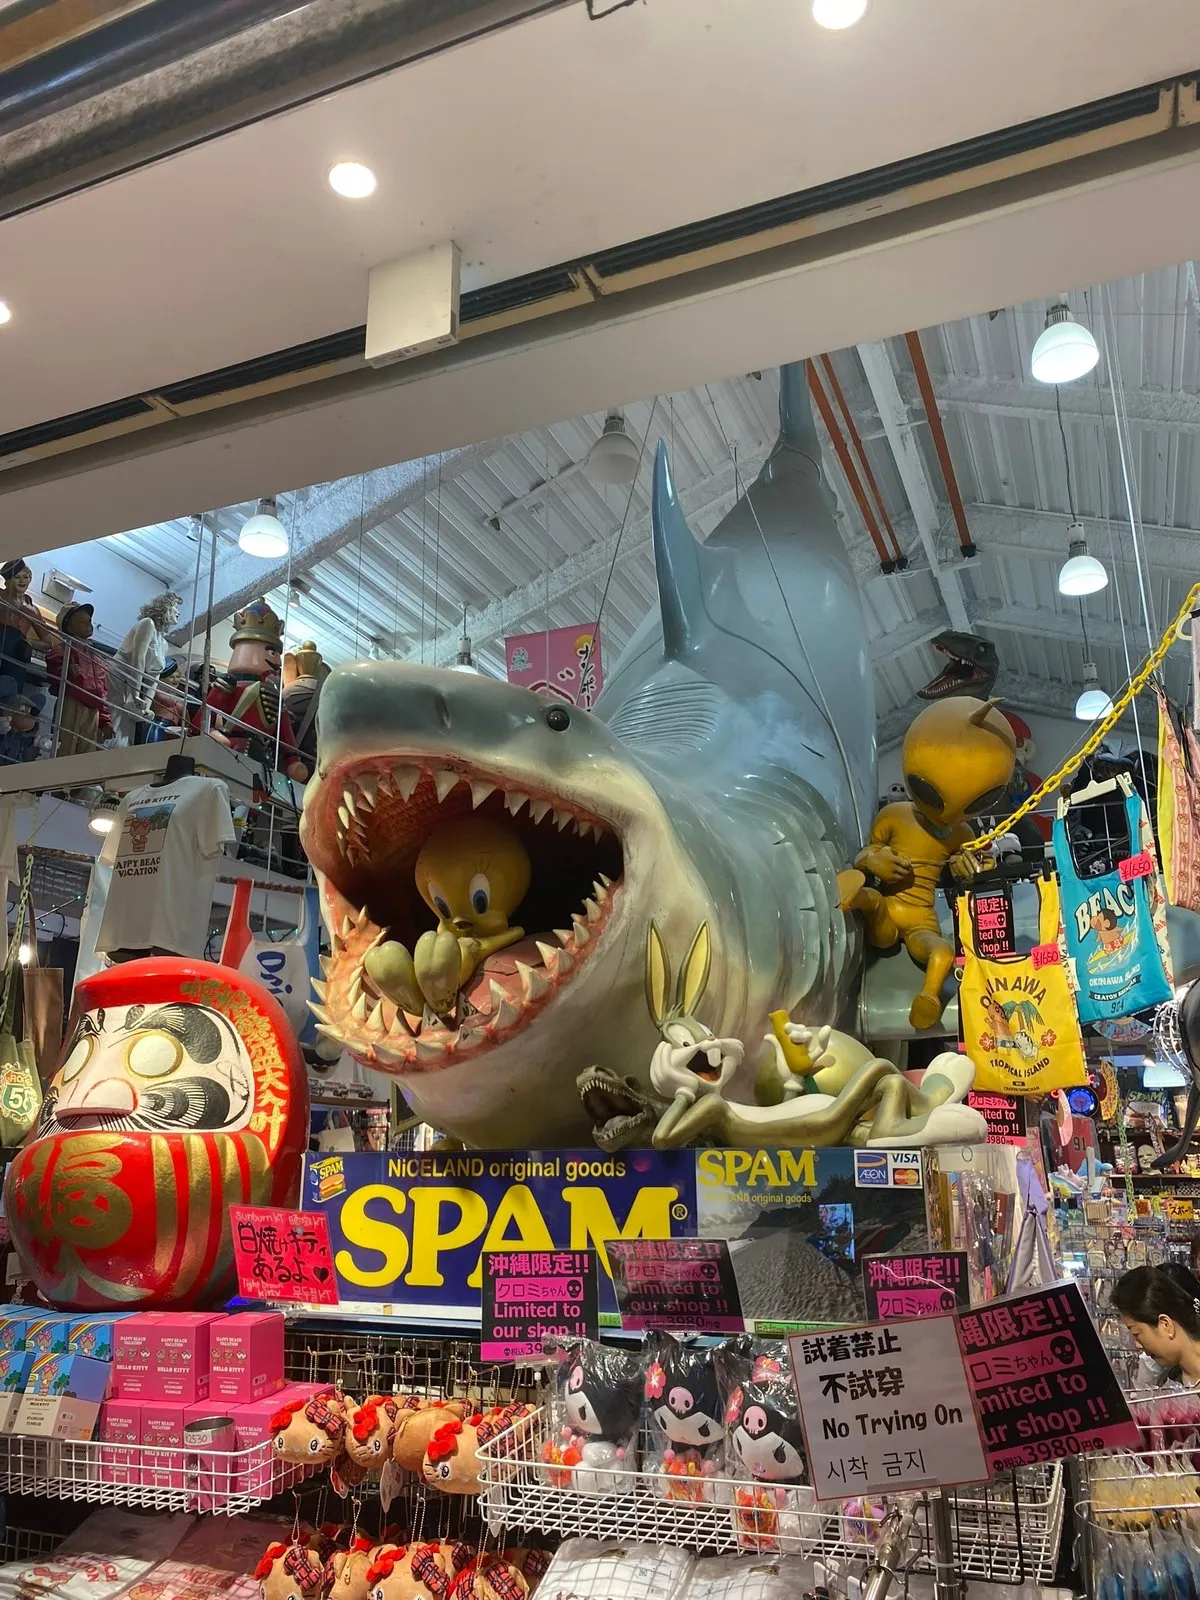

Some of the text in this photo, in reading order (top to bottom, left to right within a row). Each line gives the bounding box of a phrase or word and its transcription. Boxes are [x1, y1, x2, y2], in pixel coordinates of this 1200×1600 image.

[114, 857, 161, 869] APPY BEAC
[1121, 860, 1150, 880] ¥1650
[977, 897, 1009, 914] 限定!!
[1075, 884, 1135, 943] BEAC
[995, 929, 1006, 938] to
[1032, 951, 1059, 967] ¥1650
[990, 1057, 1050, 1078] TROPICAL ISLAND
[1005, 1110, 1016, 1120] to
[698, 1149, 818, 1187] SPAM
[892, 1153, 919, 1164] VISA
[319, 1159, 344, 1180] SPAM
[388, 1157, 627, 1182] NiCELAND original goods
[751, 1193, 784, 1205] original
[785, 1193, 812, 1205] goods
[334, 1184, 679, 1288] SPAM
[252, 1254, 311, 1284] あるよ
[488, 1252, 590, 1277] 沖縄限定!!
[497, 1281, 567, 1299] クロミちゃん
[627, 1281, 719, 1296] Limited to
[494, 1302, 581, 1319] Limited to
[630, 1301, 661, 1314] our
[667, 1299, 710, 1315] shop
[493, 1324, 523, 1339] our
[960, 1294, 1077, 1348] 縄限定!!
[801, 1328, 902, 1365] 試着禁止
[970, 1350, 1054, 1382] ロミちゃん
[819, 1366, 905, 1404] 不試穿
[979, 1373, 1088, 1415] mited to
[822, 1403, 963, 1440] No Trying On
[984, 1423, 1008, 1446] ur
[1016, 1406, 1081, 1438] shop
[827, 1448, 926, 1484] 시착 금지
